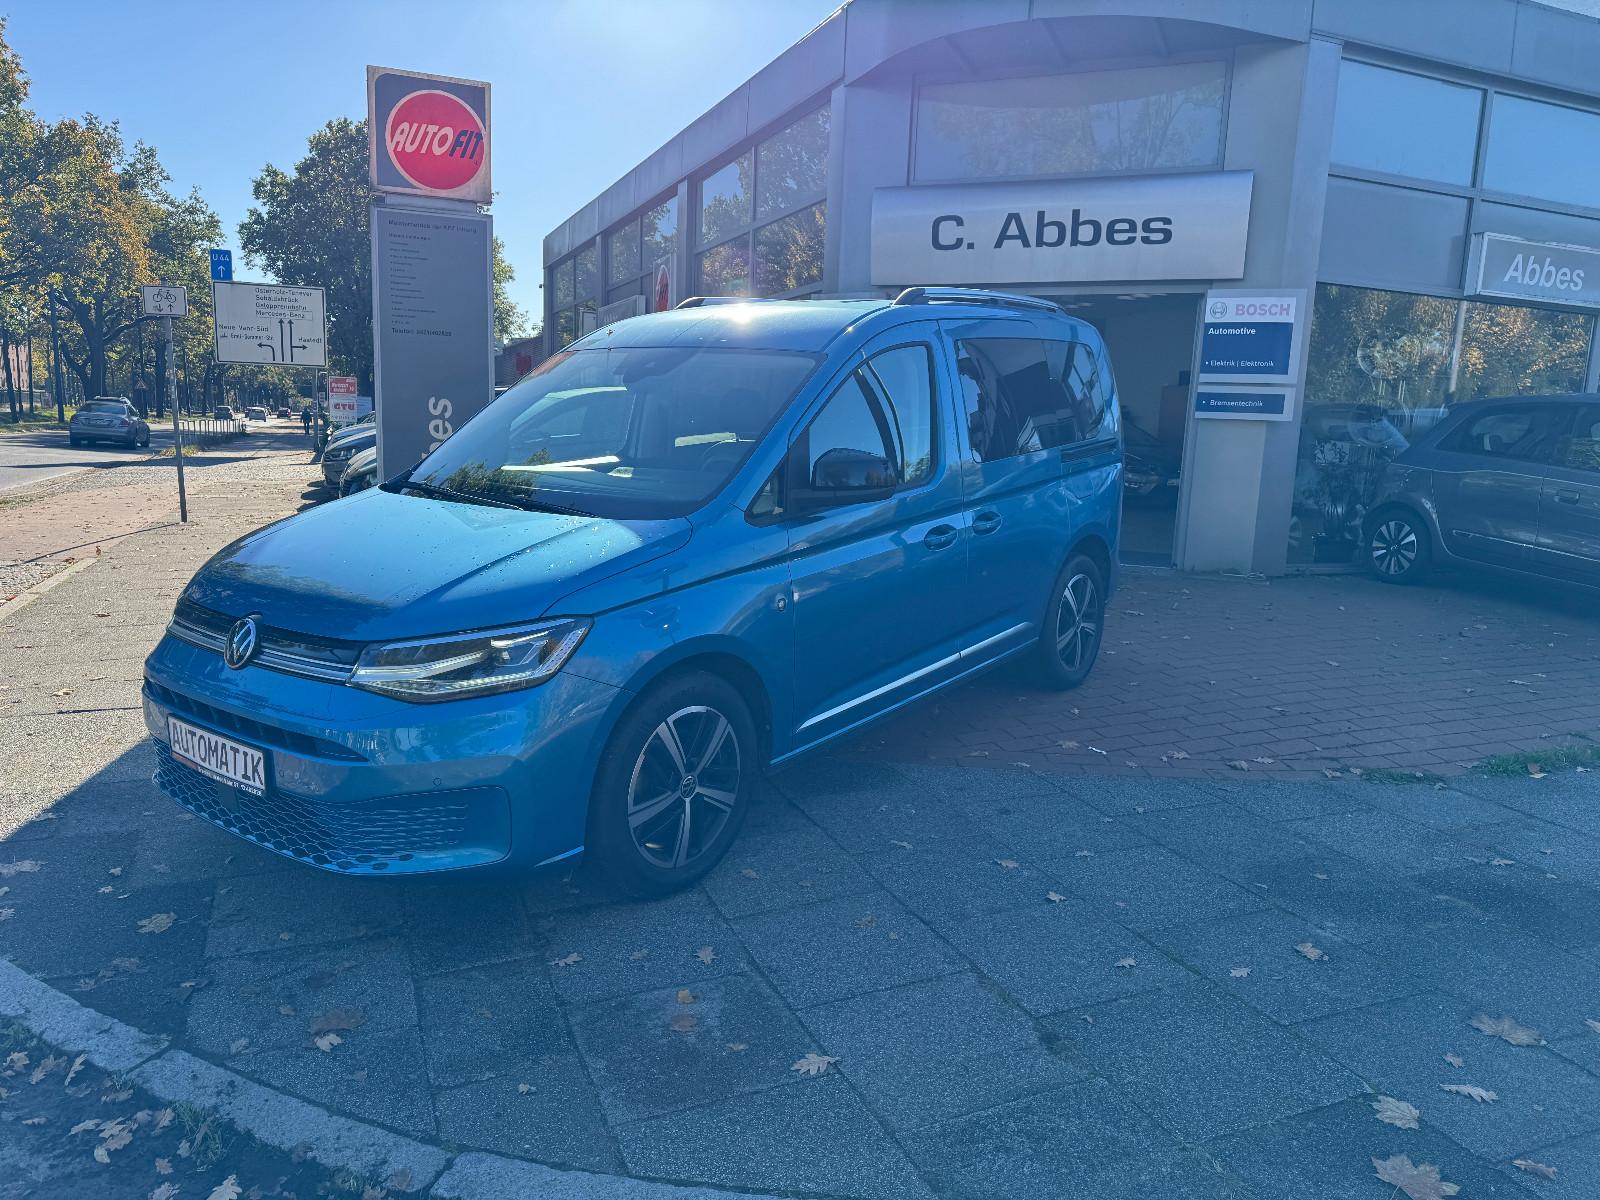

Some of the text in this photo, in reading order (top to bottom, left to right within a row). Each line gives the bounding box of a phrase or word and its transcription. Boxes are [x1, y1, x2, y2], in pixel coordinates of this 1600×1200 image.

[392, 122, 484, 160] AUTOFIT
[931, 209, 1173, 251] C. Abbes
[1503, 253, 1585, 291] Abbes
[1235, 303, 1291, 316] BOSCH
[1208, 327, 1256, 335] Automotive
[1210, 399, 1264, 407] Bremsentechnik
[172, 722, 264, 786] AUTOMATIK
